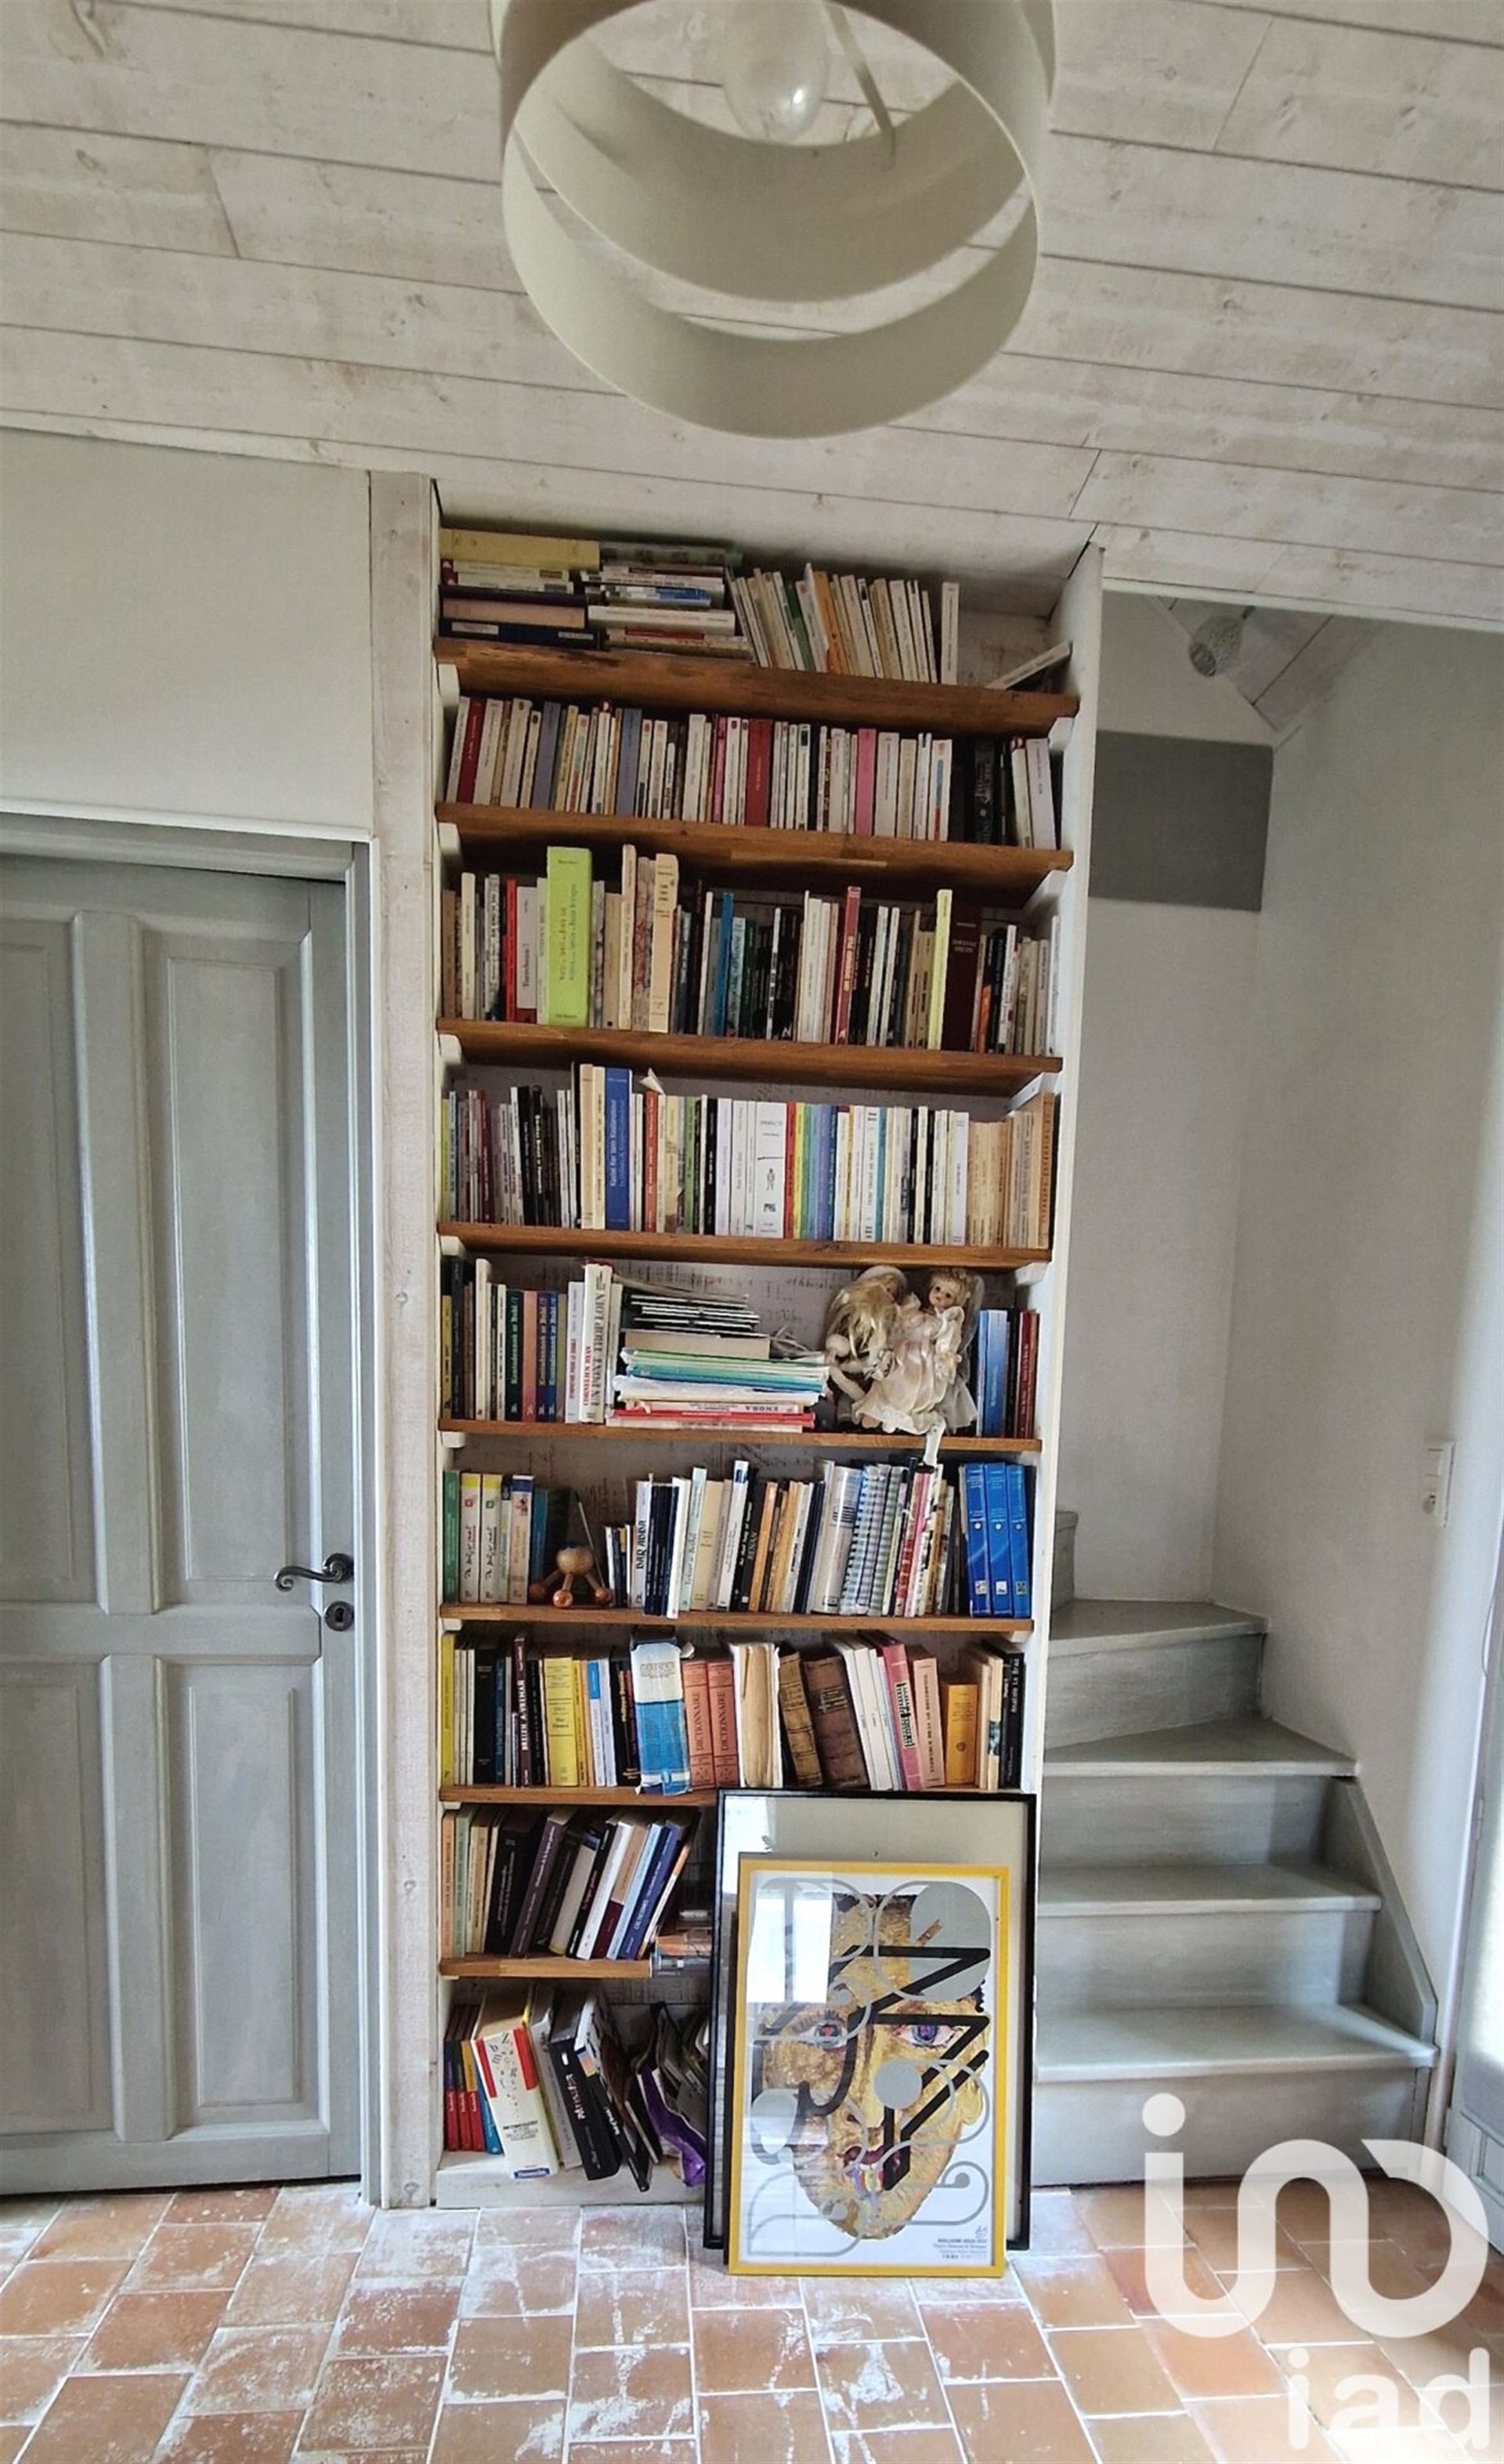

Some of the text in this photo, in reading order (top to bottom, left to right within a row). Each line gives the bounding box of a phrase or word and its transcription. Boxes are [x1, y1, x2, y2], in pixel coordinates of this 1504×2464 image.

[593, 1293, 606, 1320] LOIN
[592, 1322, 603, 1352] TROP
[591, 1358, 602, 1388] PONT
[692, 1692, 702, 1751] DICTIONNAIRE
[718, 1692, 728, 1751] DICTIONNAIRE
